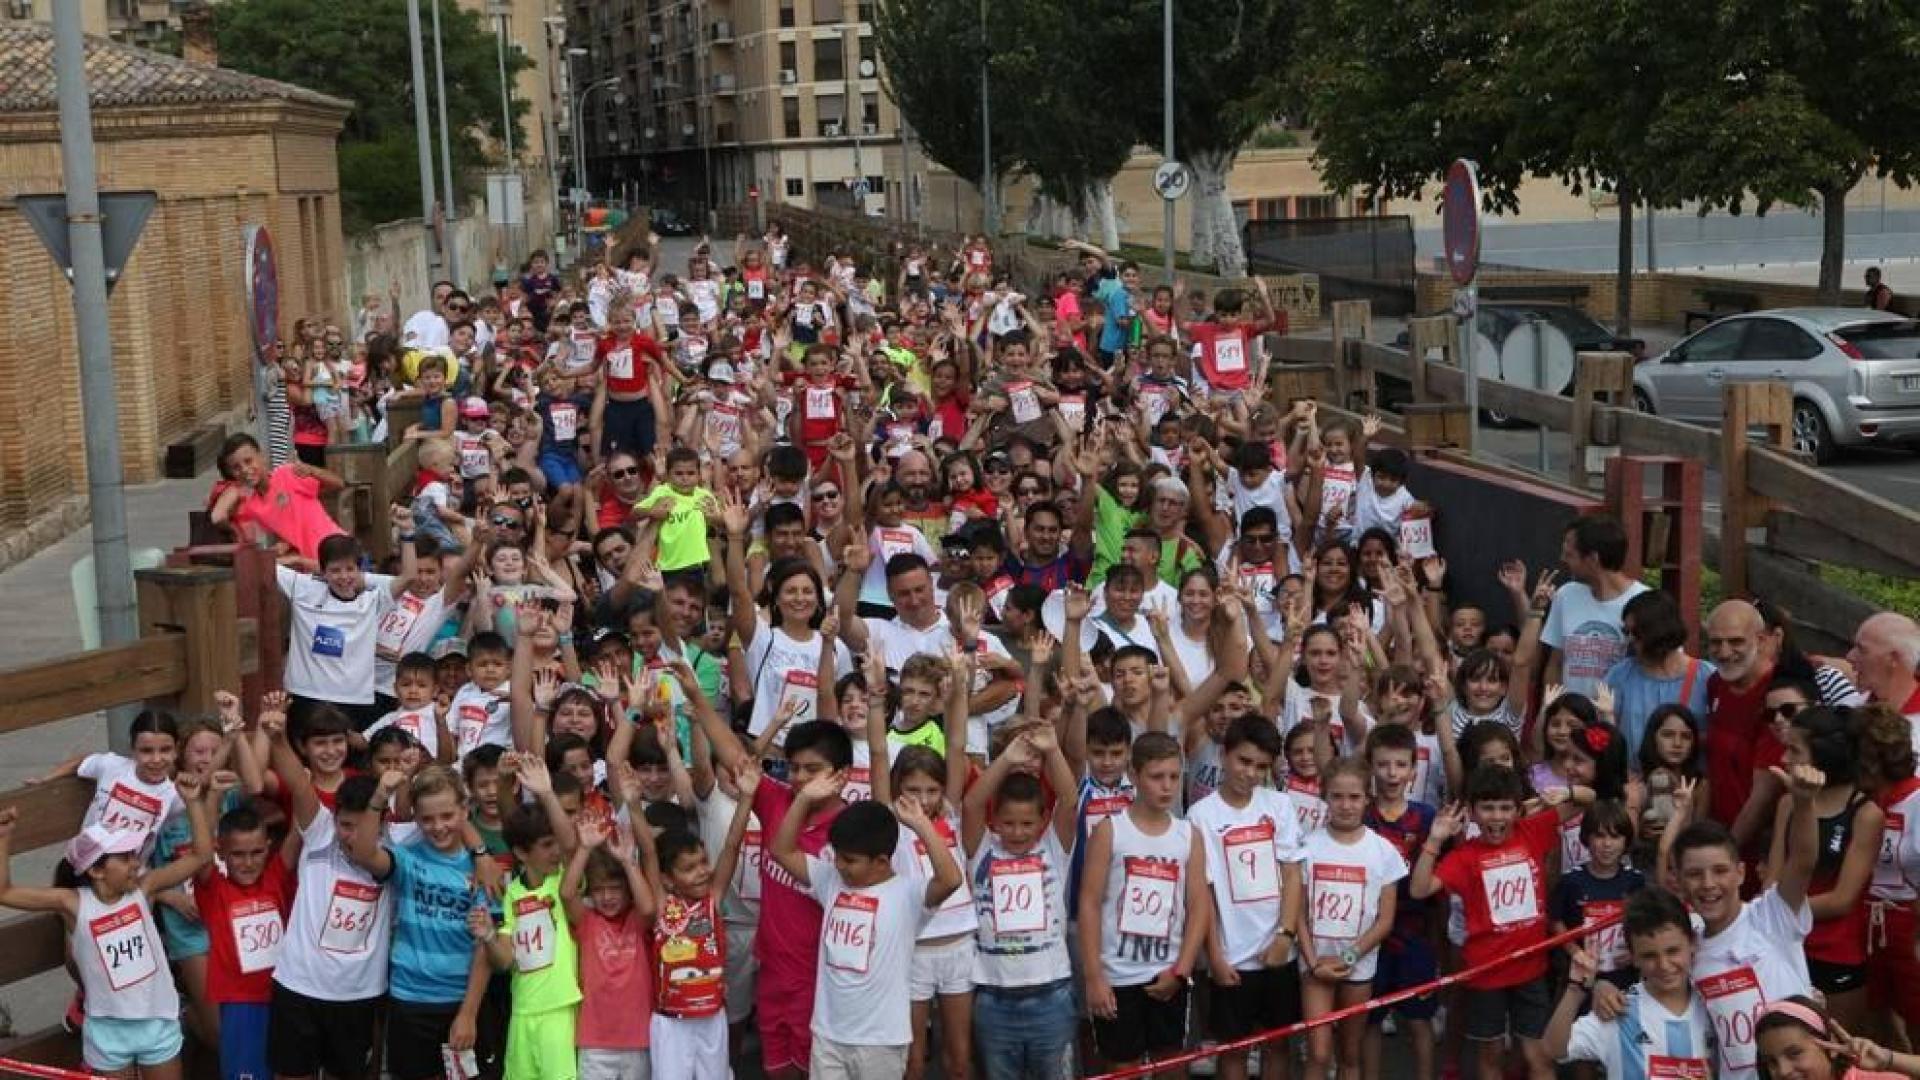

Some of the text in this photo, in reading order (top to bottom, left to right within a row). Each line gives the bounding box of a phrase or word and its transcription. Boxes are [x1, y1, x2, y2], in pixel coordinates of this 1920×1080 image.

[1159, 171, 1184, 188] 20
[1239, 849, 1256, 881] 9
[1000, 883, 1031, 913] 20
[1131, 887, 1162, 916] 30
[1316, 891, 1353, 921] 182
[1492, 876, 1527, 910] 104
[331, 907, 370, 932] 365
[241, 920, 280, 952] 580
[106, 935, 144, 969] 247
